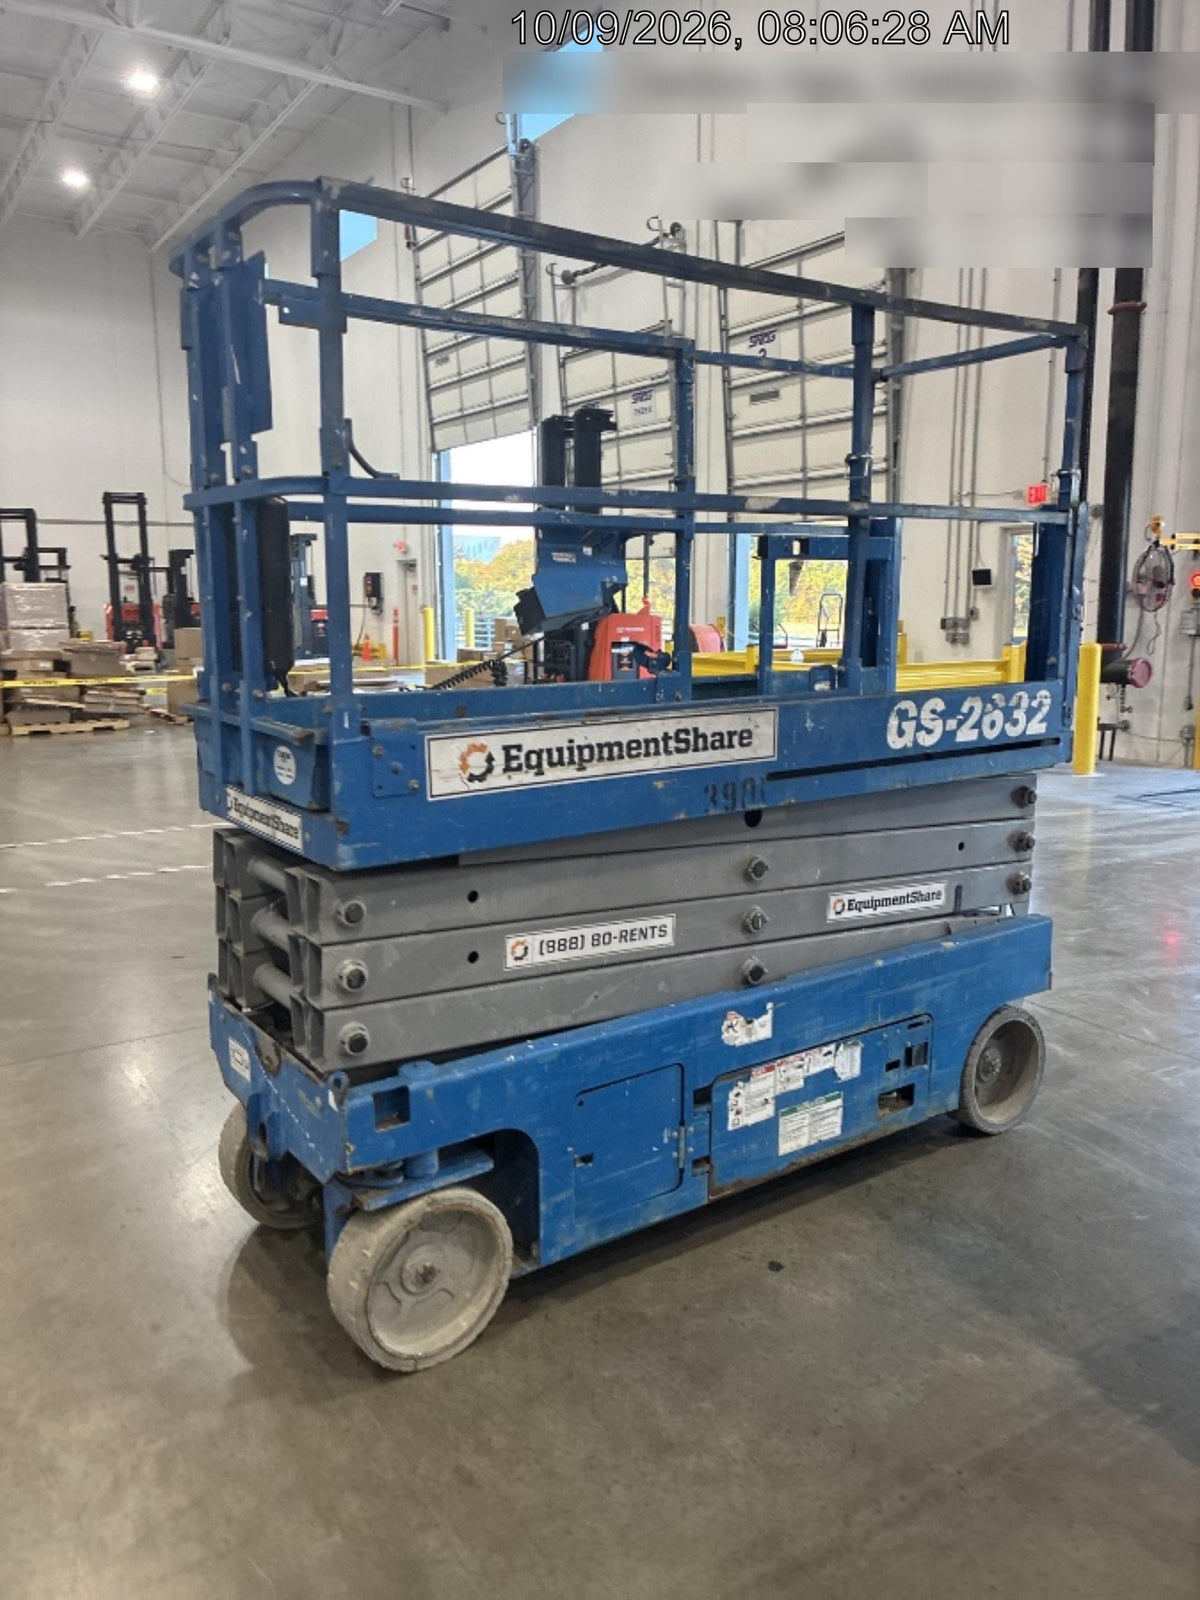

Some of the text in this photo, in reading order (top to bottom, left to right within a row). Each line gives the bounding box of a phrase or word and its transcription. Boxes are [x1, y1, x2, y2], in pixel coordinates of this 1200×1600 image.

[1028, 485, 1048, 504] EXIT
[501, 726, 754, 776] EquipmentShare
[847, 890, 943, 912] EquipmentShare
